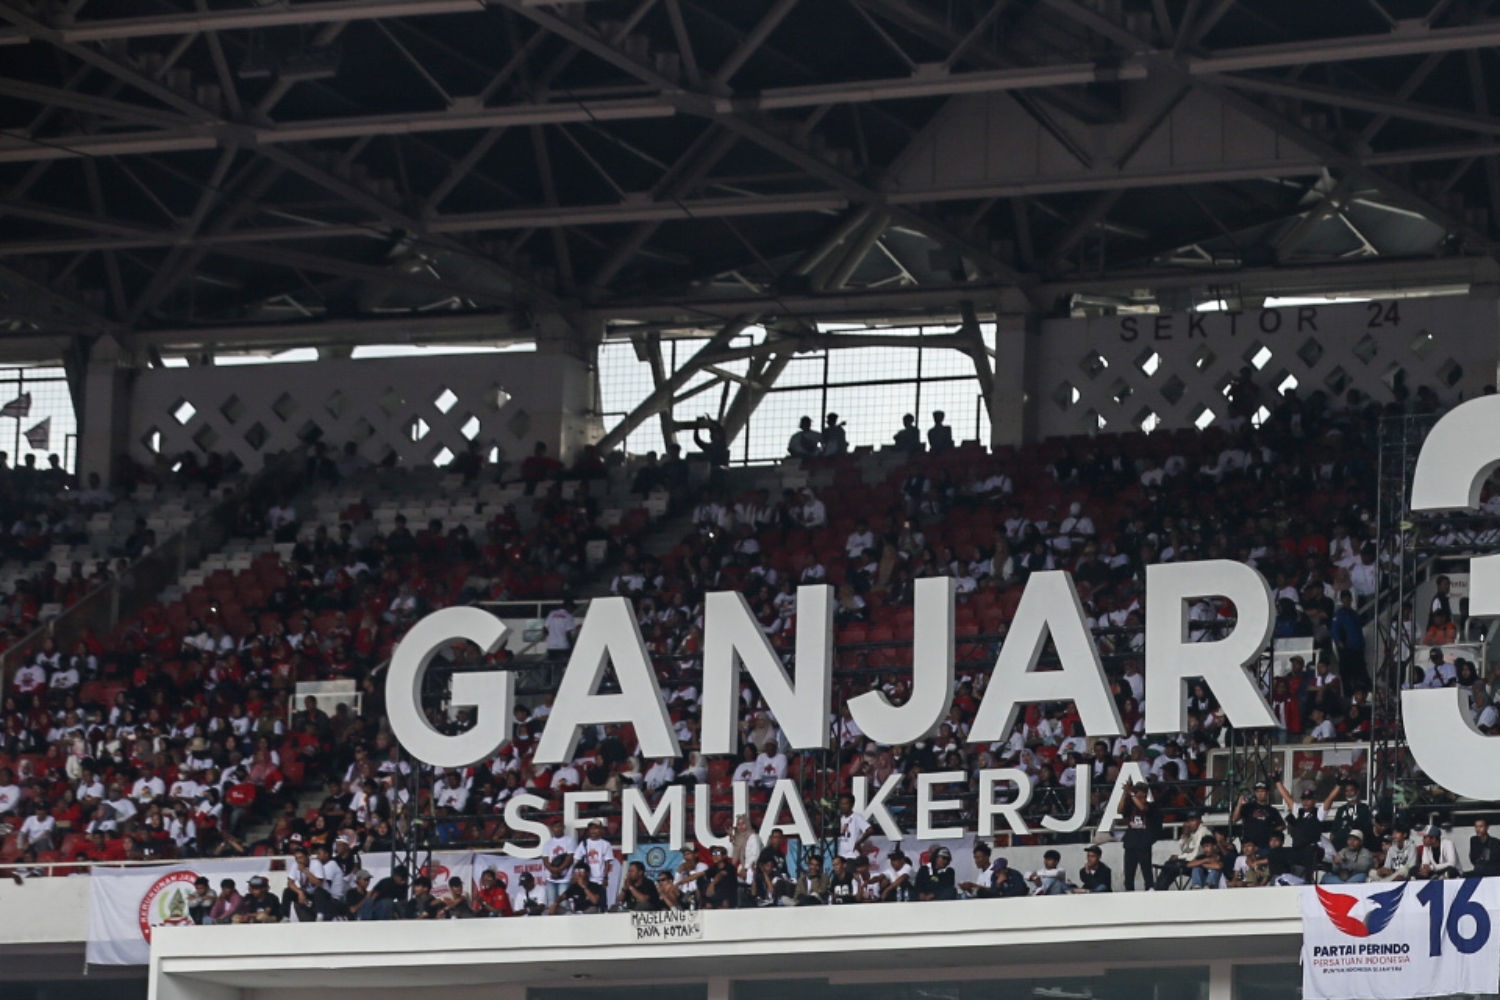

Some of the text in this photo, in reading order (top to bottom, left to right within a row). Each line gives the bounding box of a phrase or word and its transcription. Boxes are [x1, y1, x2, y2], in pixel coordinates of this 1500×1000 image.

[1119, 301, 1401, 341] SEKTOR 24
[386, 559, 1282, 767] GANJAR
[502, 762, 1153, 859] SEMUA KERJA
[1416, 878, 1491, 957] 16
[1313, 943, 1410, 957] PARTAI PERINDO
[1313, 955, 1410, 967] PERSATUAN INDONESIA
